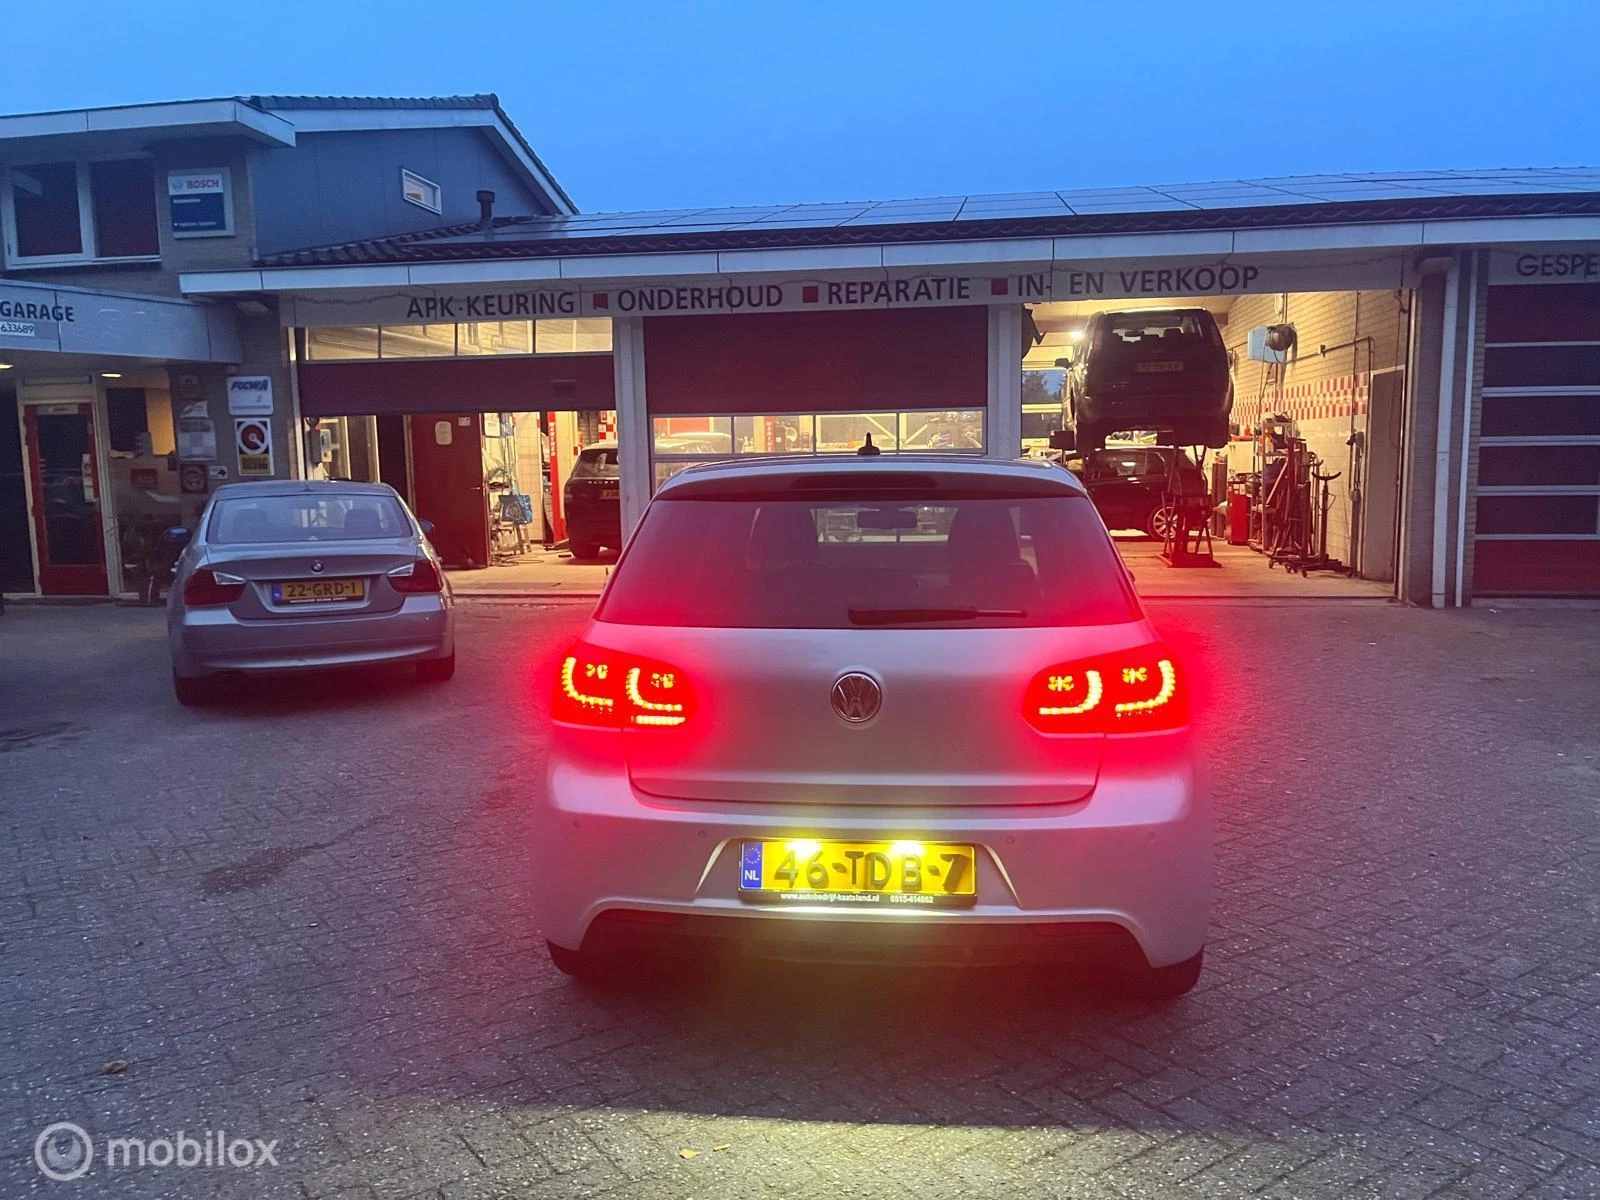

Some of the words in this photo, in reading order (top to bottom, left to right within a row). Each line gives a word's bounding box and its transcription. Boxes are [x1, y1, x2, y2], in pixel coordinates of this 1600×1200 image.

[187, 179, 219, 189] BOSCH
[618, 285, 783, 312] ONDERHOUD
[828, 277, 970, 305] REPARATIE
[1069, 273, 1104, 295] EN
[1120, 266, 1259, 292] VERKOOP
[0, 301, 75, 322] GARAGE
[287, 582, 356, 598] 22-GRD-1
[744, 870, 760, 881] NL
[774, 848, 969, 892] 46-TDB-7
